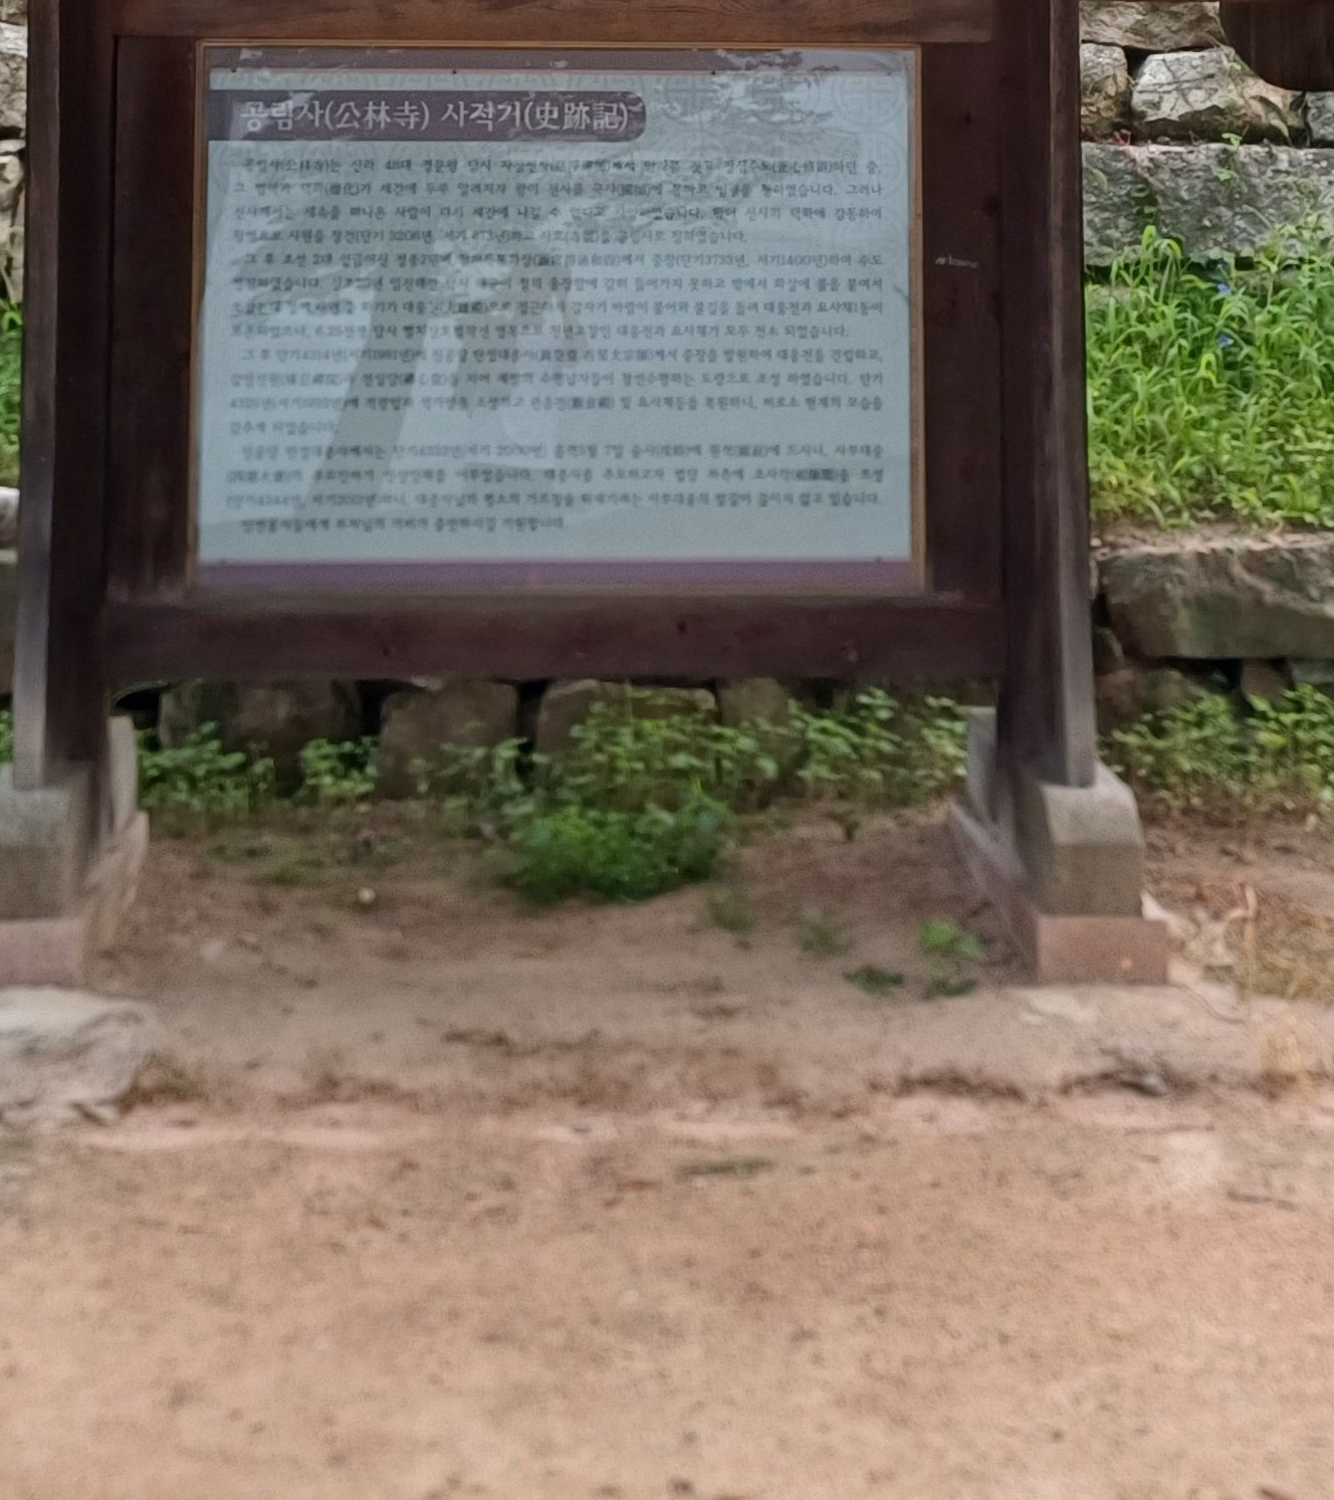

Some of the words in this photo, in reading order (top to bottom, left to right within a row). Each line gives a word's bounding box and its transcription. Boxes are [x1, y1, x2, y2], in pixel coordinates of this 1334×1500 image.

[241, 99, 430, 132] 공림사(公林寺)
[845, 182, 882, 197] 그러나
